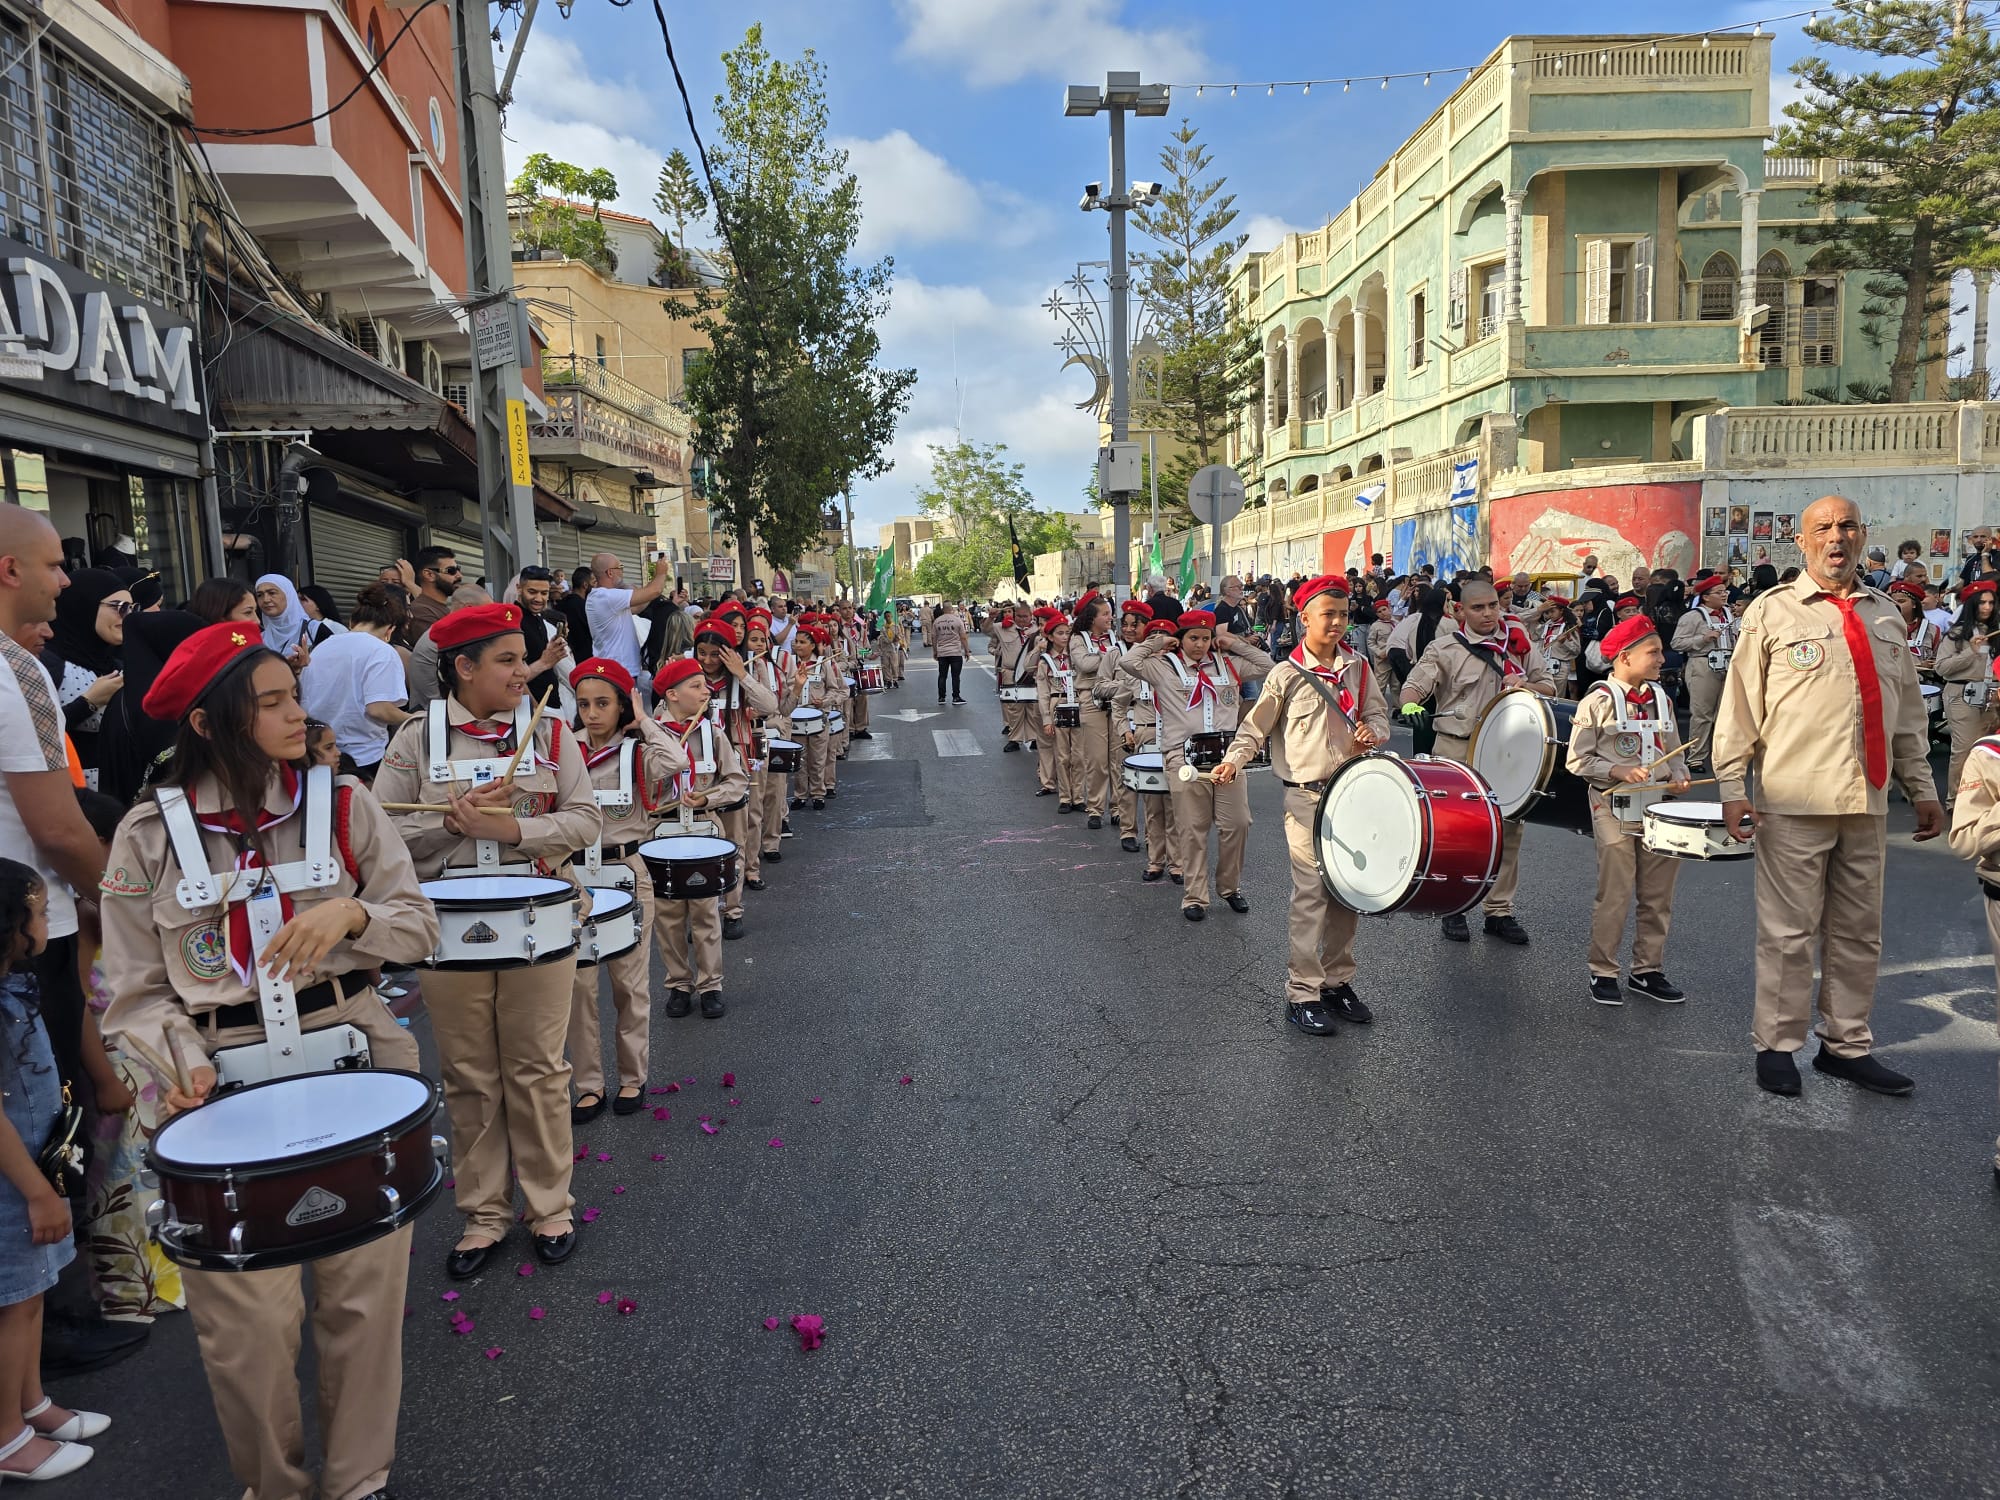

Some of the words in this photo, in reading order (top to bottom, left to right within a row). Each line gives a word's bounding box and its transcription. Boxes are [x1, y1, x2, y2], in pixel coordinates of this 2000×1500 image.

[496, 321, 510, 333] מתח
[495, 330, 511, 342] סכנת
[514, 408, 525, 481] 10584
